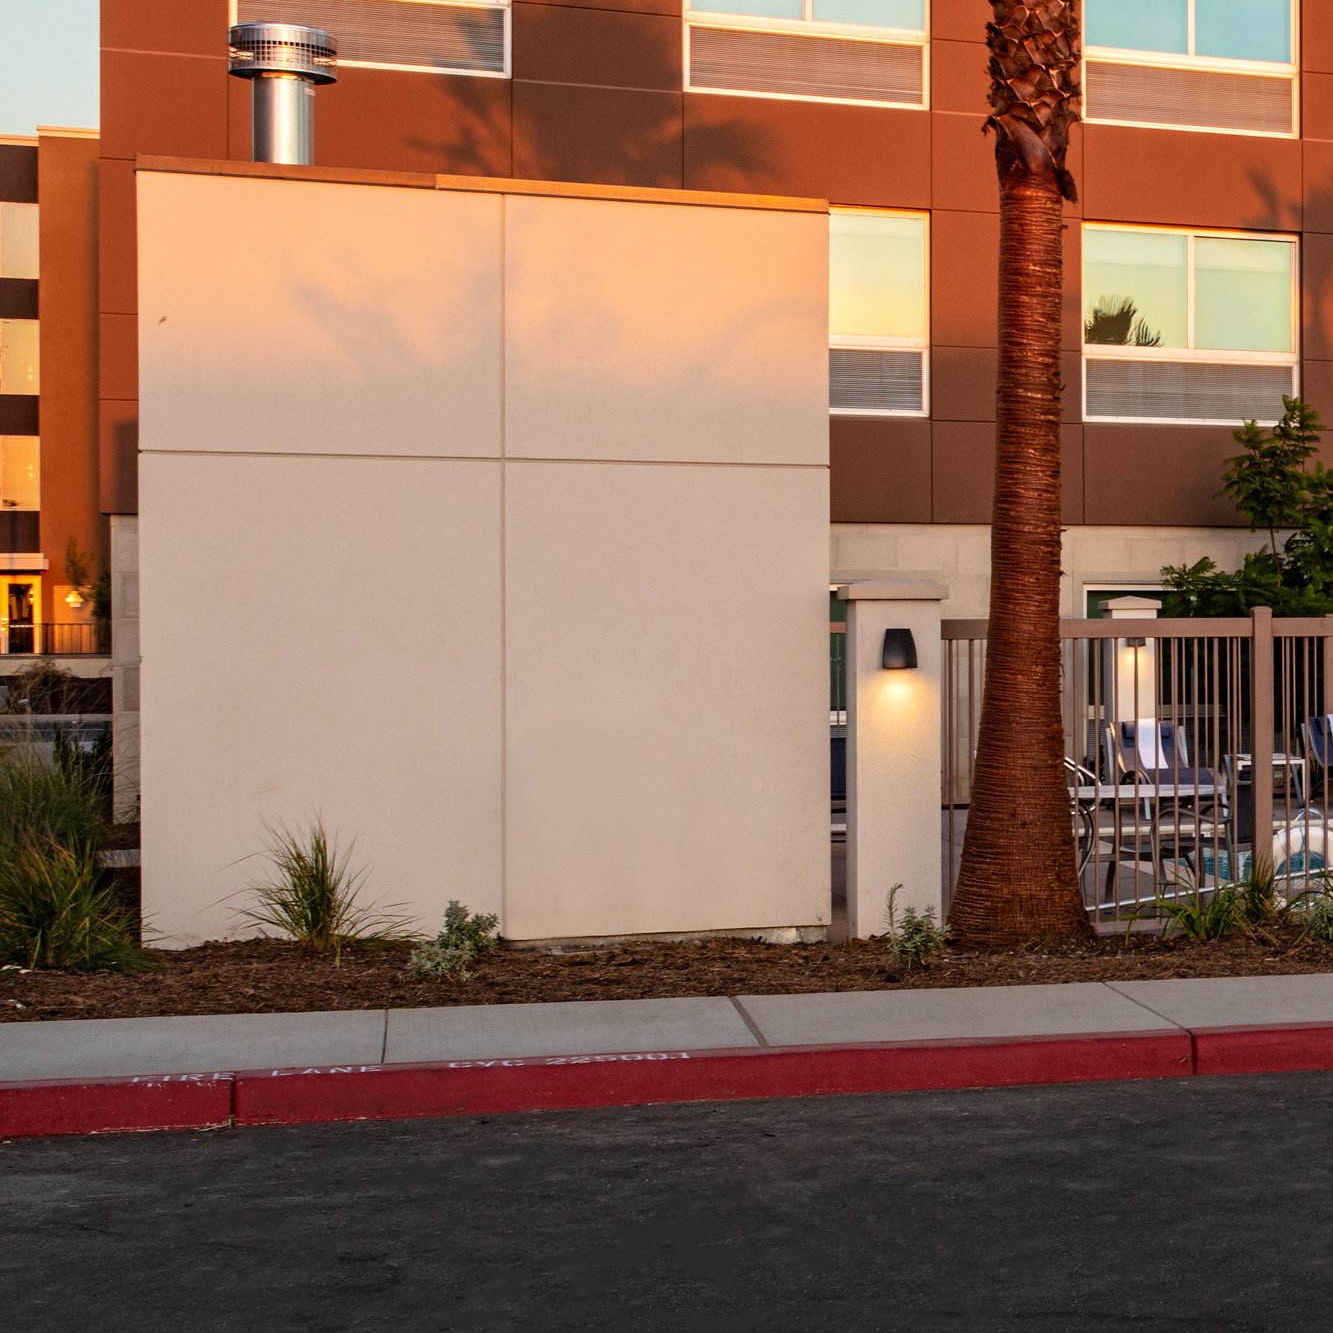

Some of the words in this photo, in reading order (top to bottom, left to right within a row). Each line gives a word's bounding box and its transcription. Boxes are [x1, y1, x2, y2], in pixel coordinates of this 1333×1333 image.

[131, 1072, 236, 1083] FIRE
[271, 1065, 382, 1077] LANE
[448, 1059, 525, 1068] CVC
[546, 1052, 691, 1065] 22500.1
